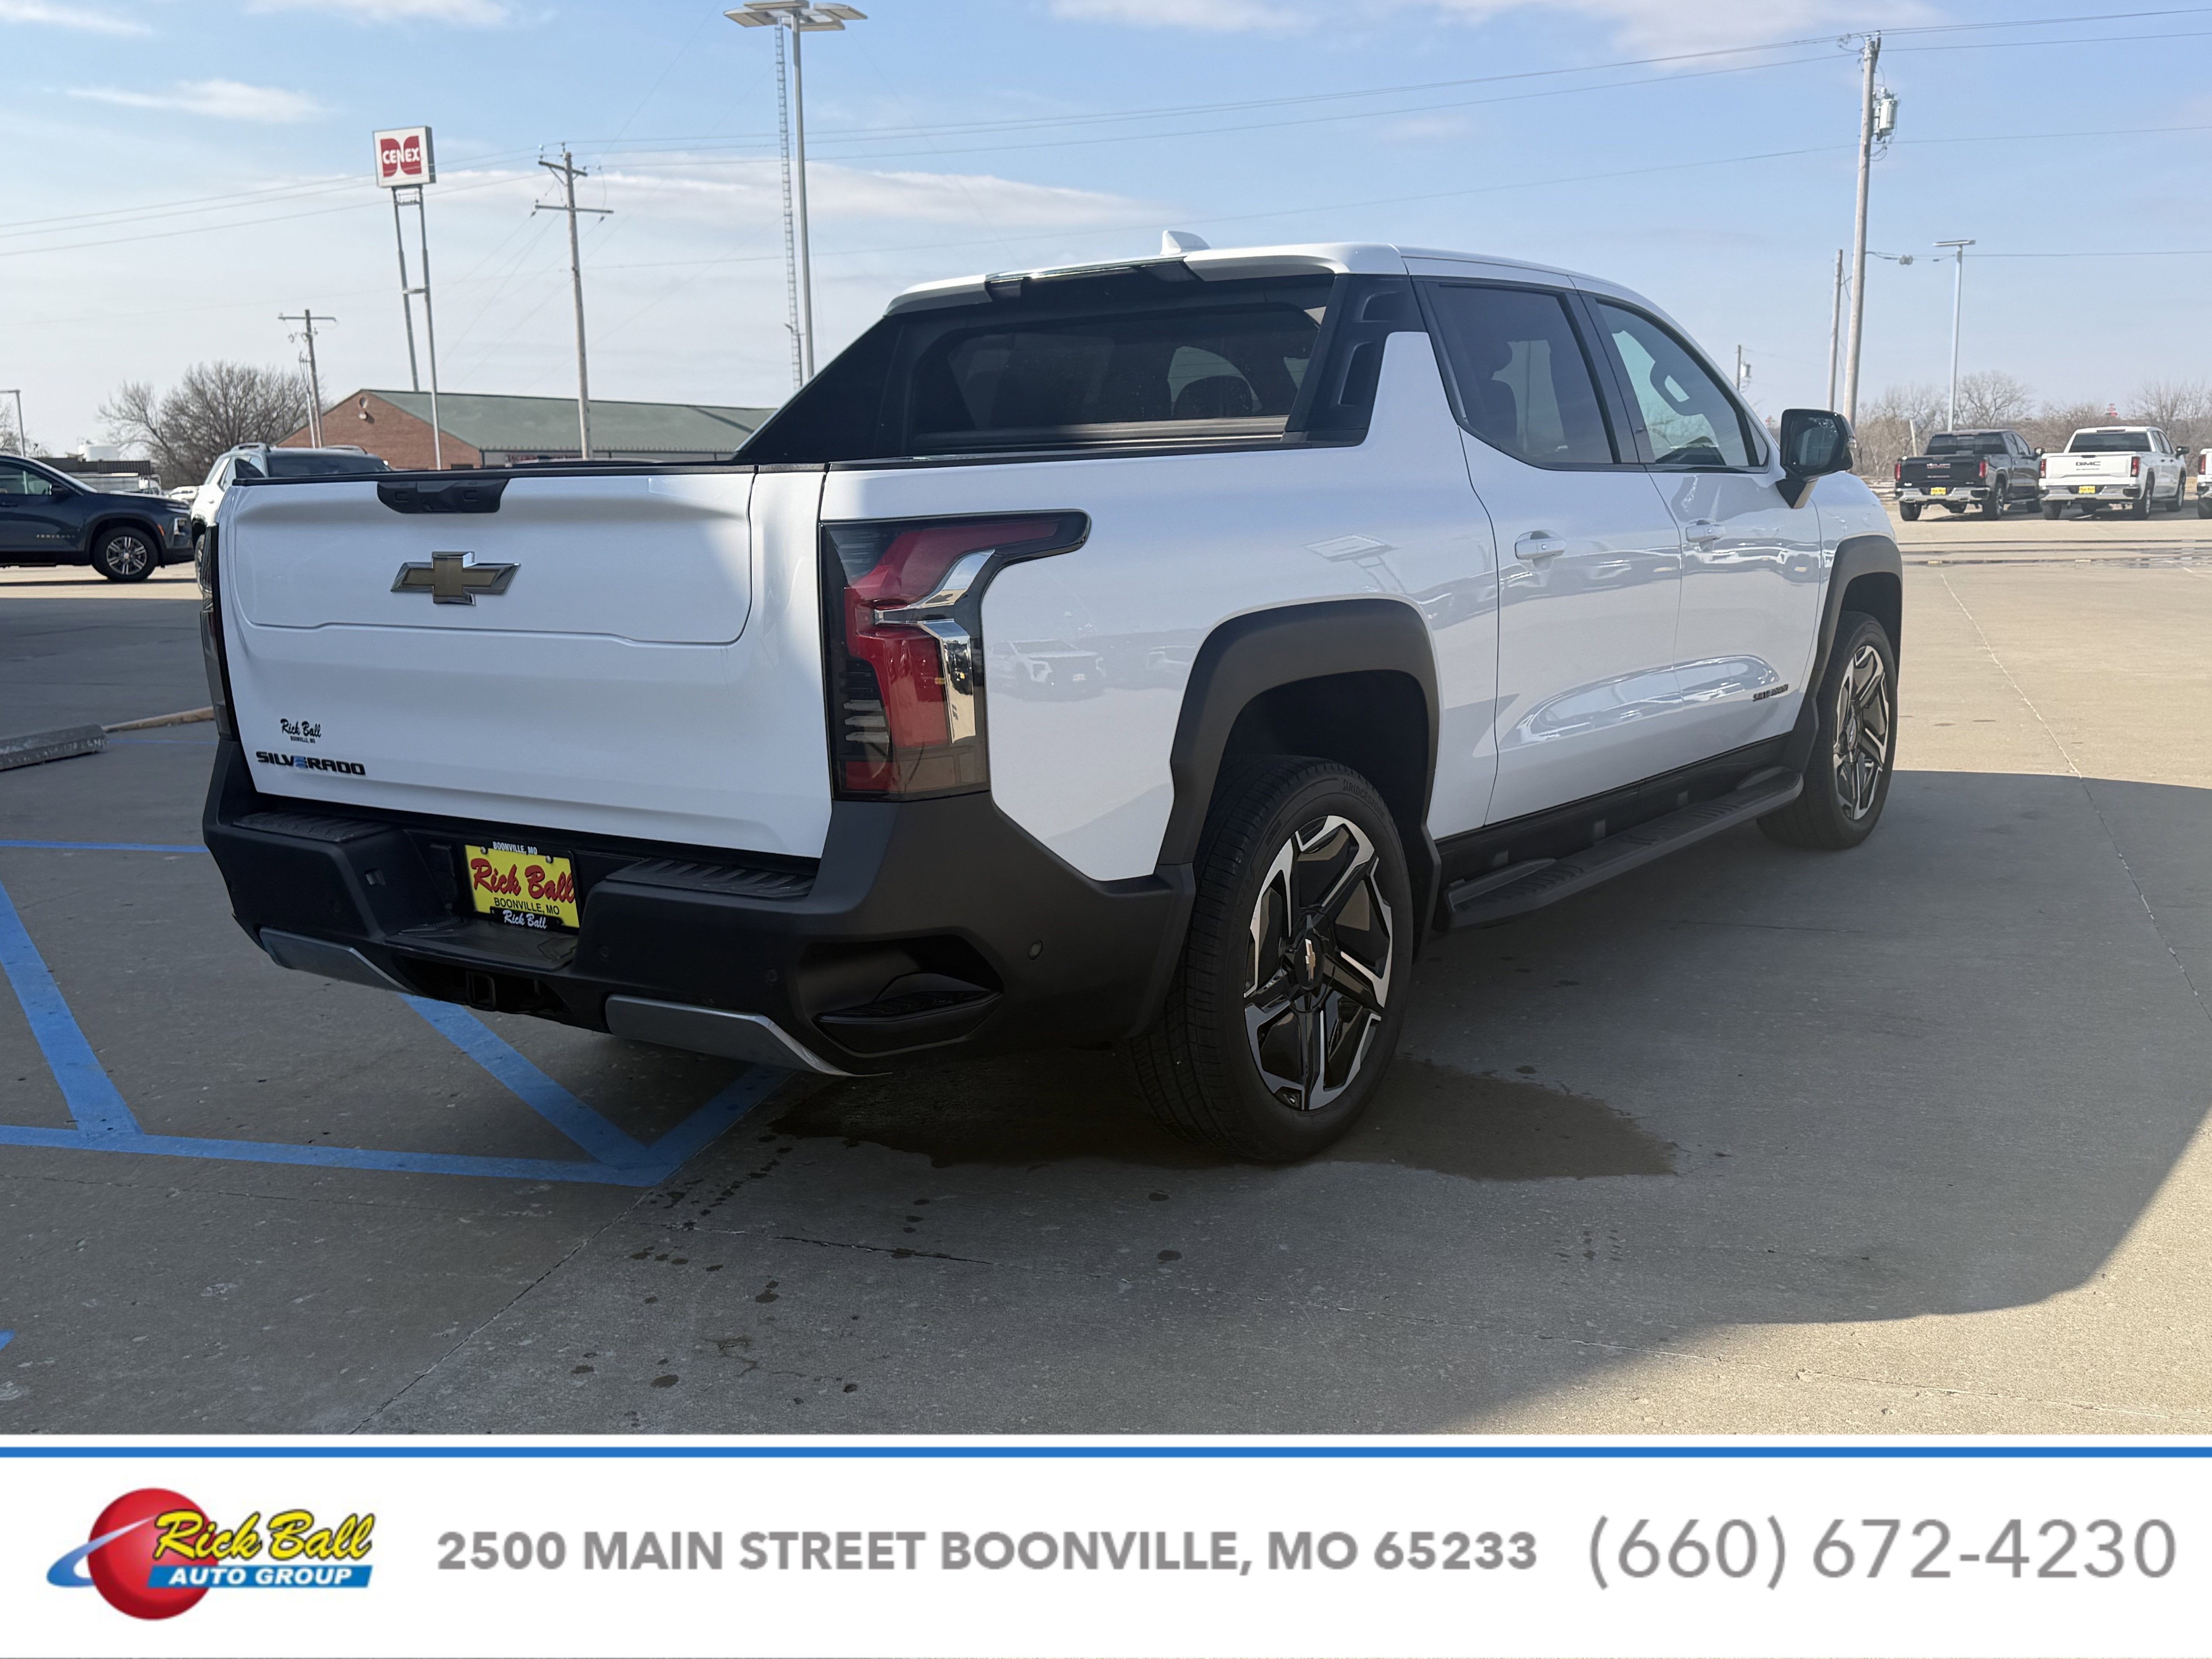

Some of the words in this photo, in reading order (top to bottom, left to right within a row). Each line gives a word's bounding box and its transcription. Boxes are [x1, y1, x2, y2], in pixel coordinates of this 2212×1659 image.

[383, 148, 420, 164] CENEX
[280, 718, 301, 735] Rick
[302, 721, 321, 738] Ball
[256, 751, 366, 775] SILVERADO
[493, 841, 527, 854] BOONVILLE,
[527, 846, 538, 855] MO
[471, 858, 521, 896] Rick
[524, 865, 575, 903] Ball
[494, 897, 544, 914] BOONVILLE,
[546, 905, 560, 915] MO
[503, 910, 525, 925] Rick
[526, 913, 547, 929] Ball
